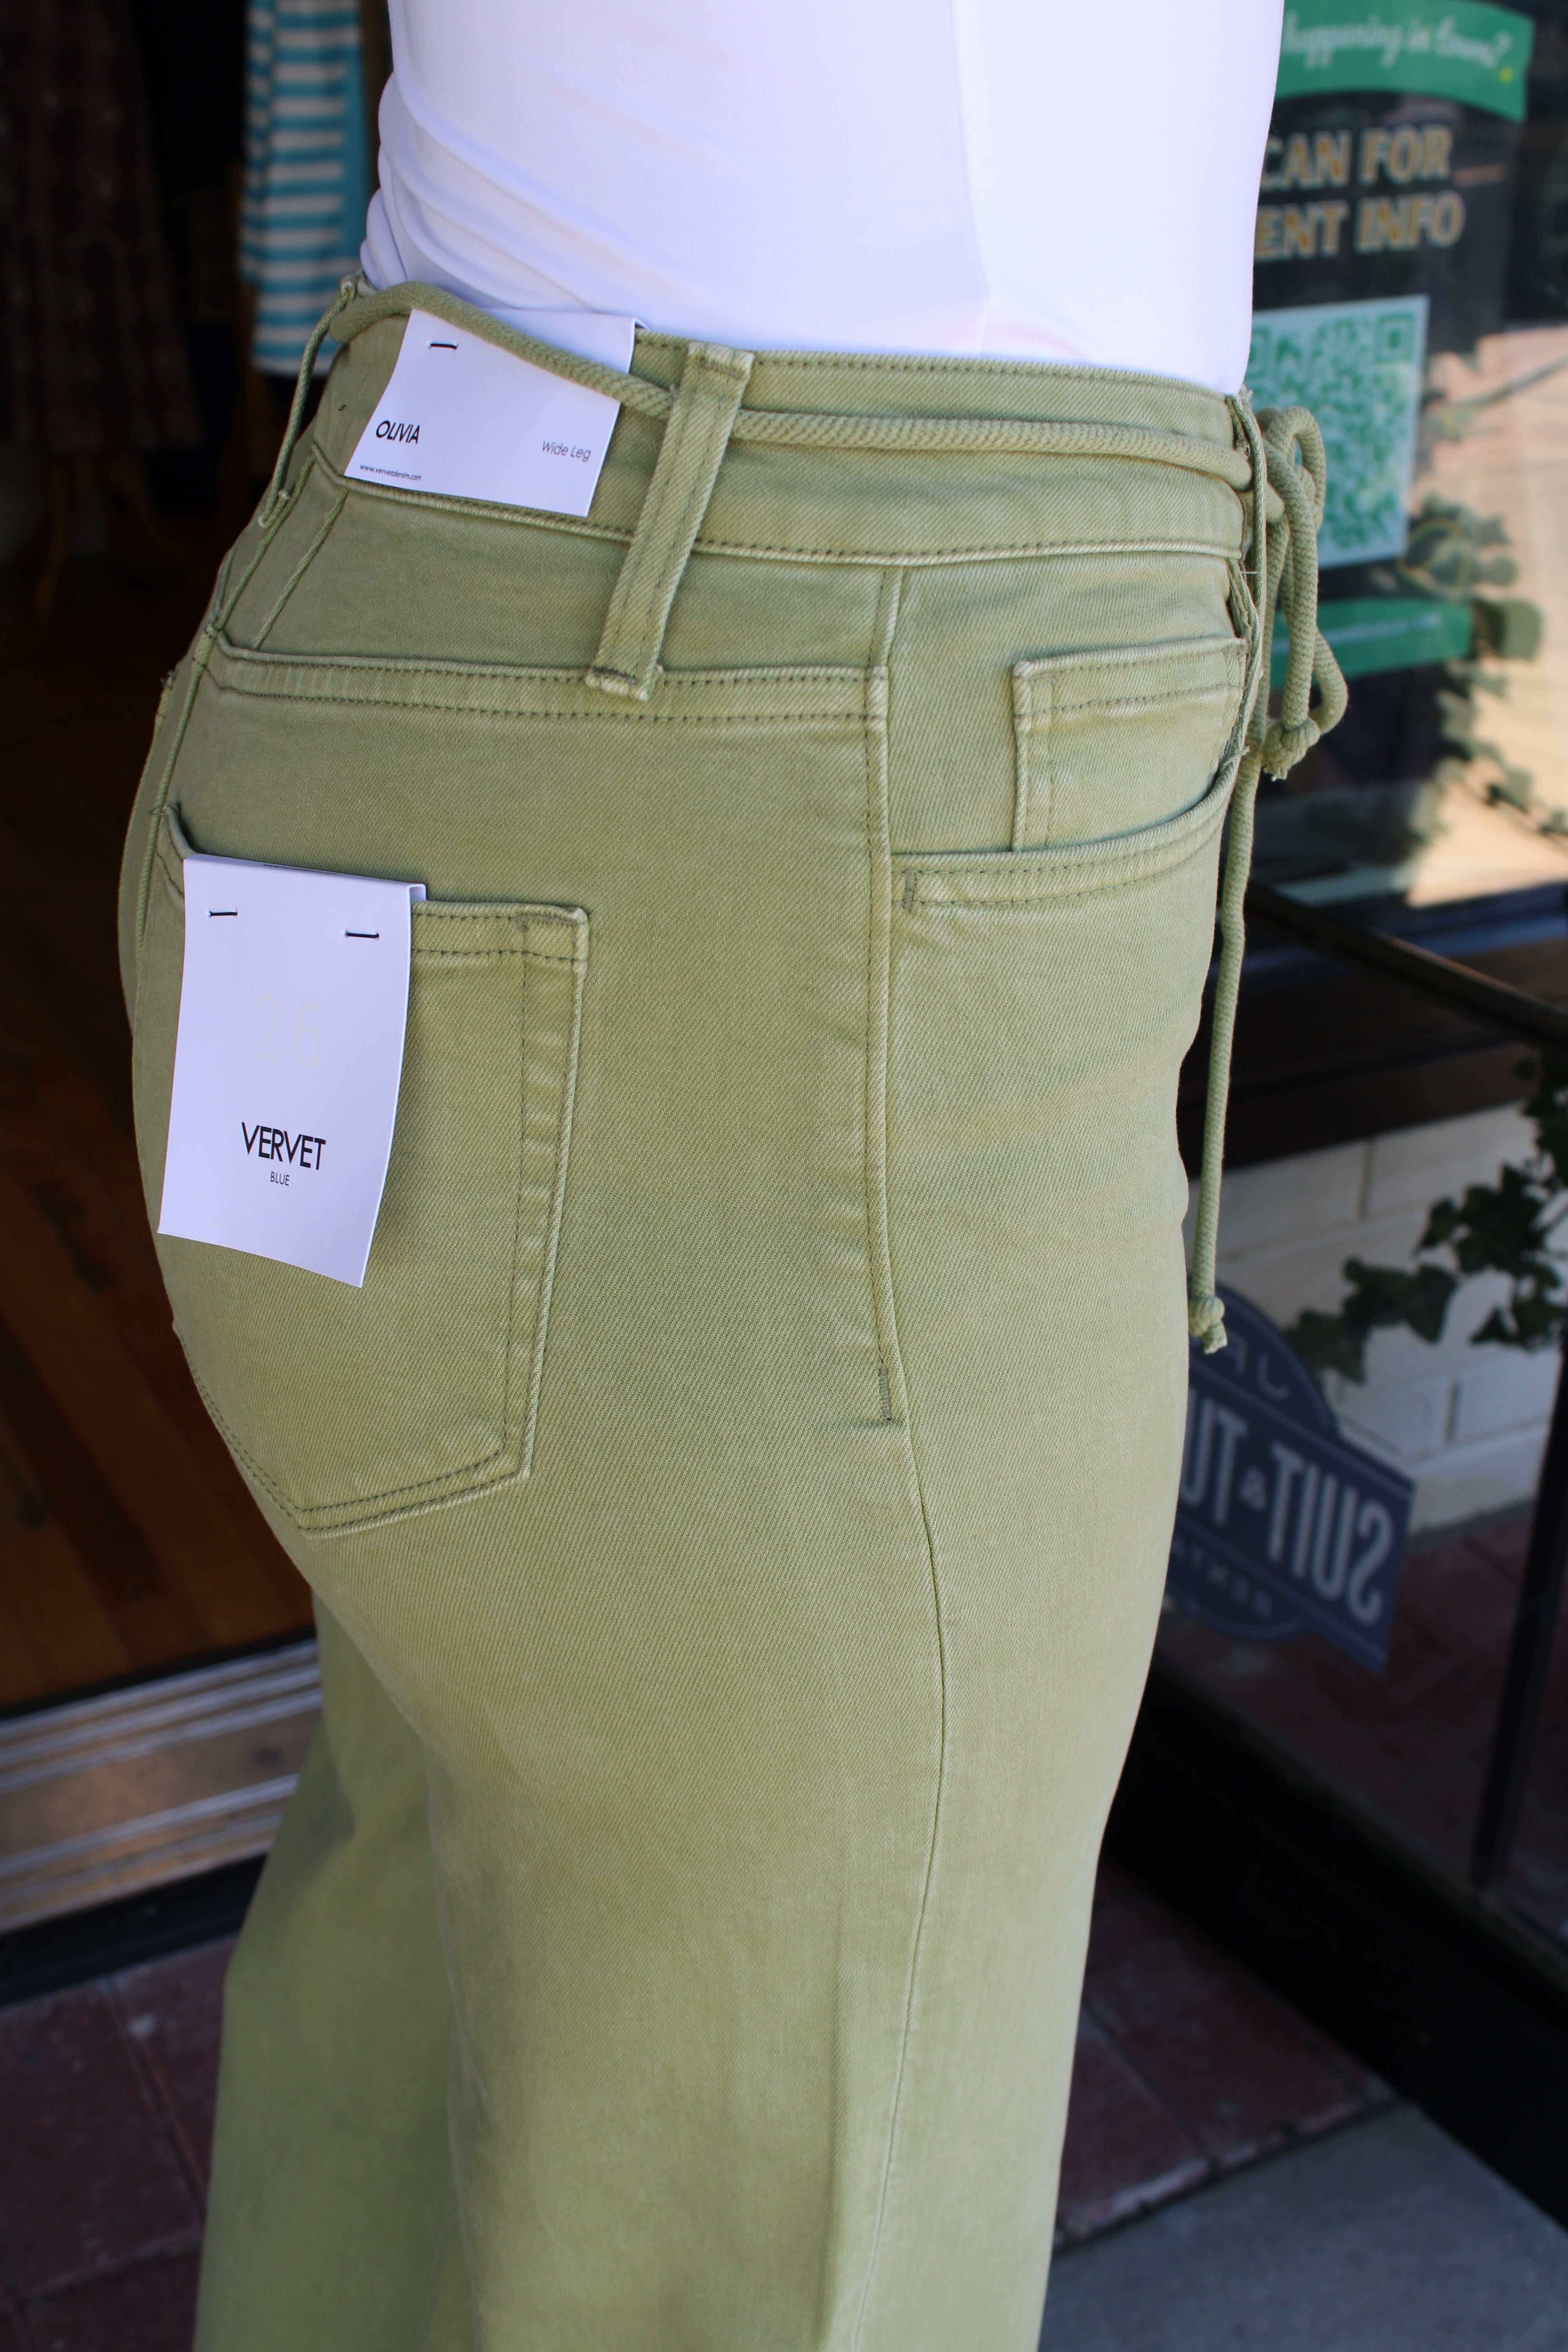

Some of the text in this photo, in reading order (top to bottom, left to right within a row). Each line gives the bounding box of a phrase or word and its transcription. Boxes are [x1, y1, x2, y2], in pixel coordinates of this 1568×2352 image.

[1361, 126, 1452, 183] FOR
[1357, 191, 1464, 252] INFO
[376, 420, 420, 444] OLIVIA
[542, 440, 591, 462] Wide Leg
[359, 465, 421, 481] www.vervetdenim.com
[241, 1122, 326, 1171] VERVET
[270, 1171, 290, 1186] BLUE
